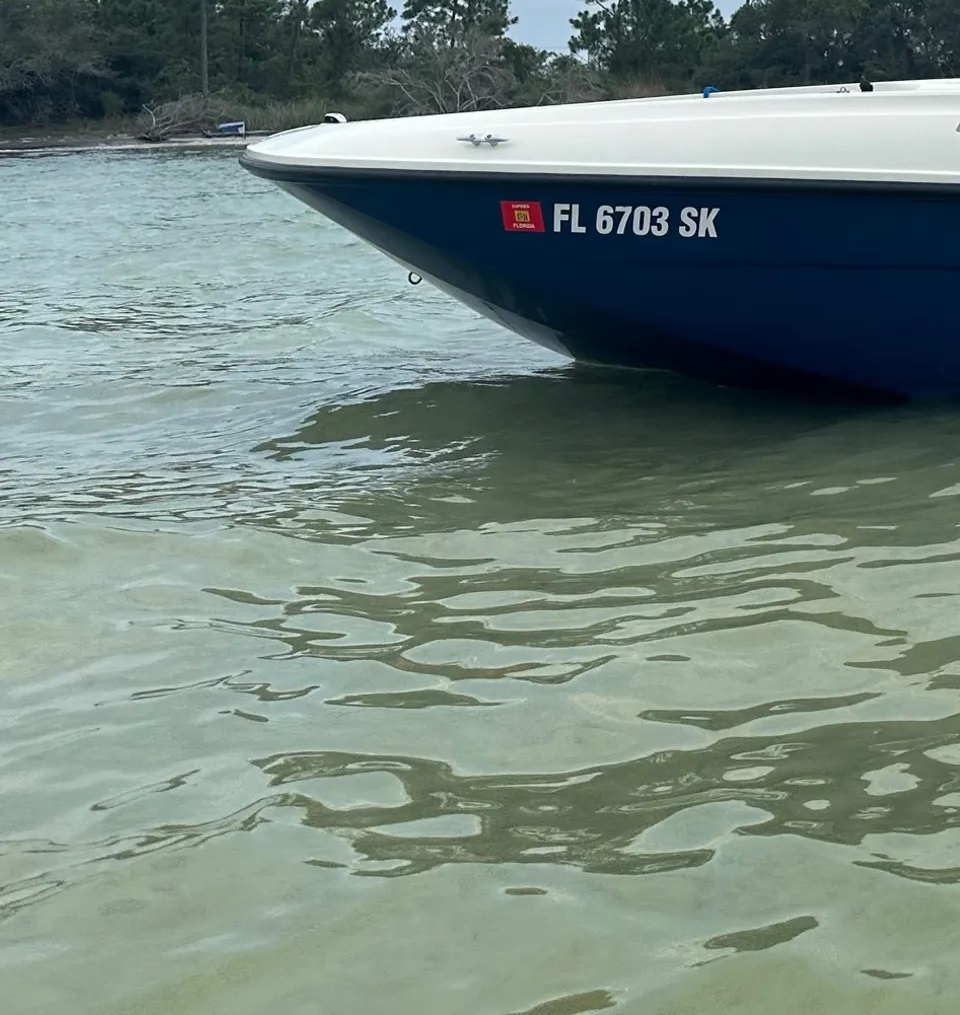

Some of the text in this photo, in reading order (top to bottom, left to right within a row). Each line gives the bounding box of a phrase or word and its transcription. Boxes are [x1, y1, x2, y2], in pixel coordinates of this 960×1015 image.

[553, 203, 721, 238] FL 6703 SK
